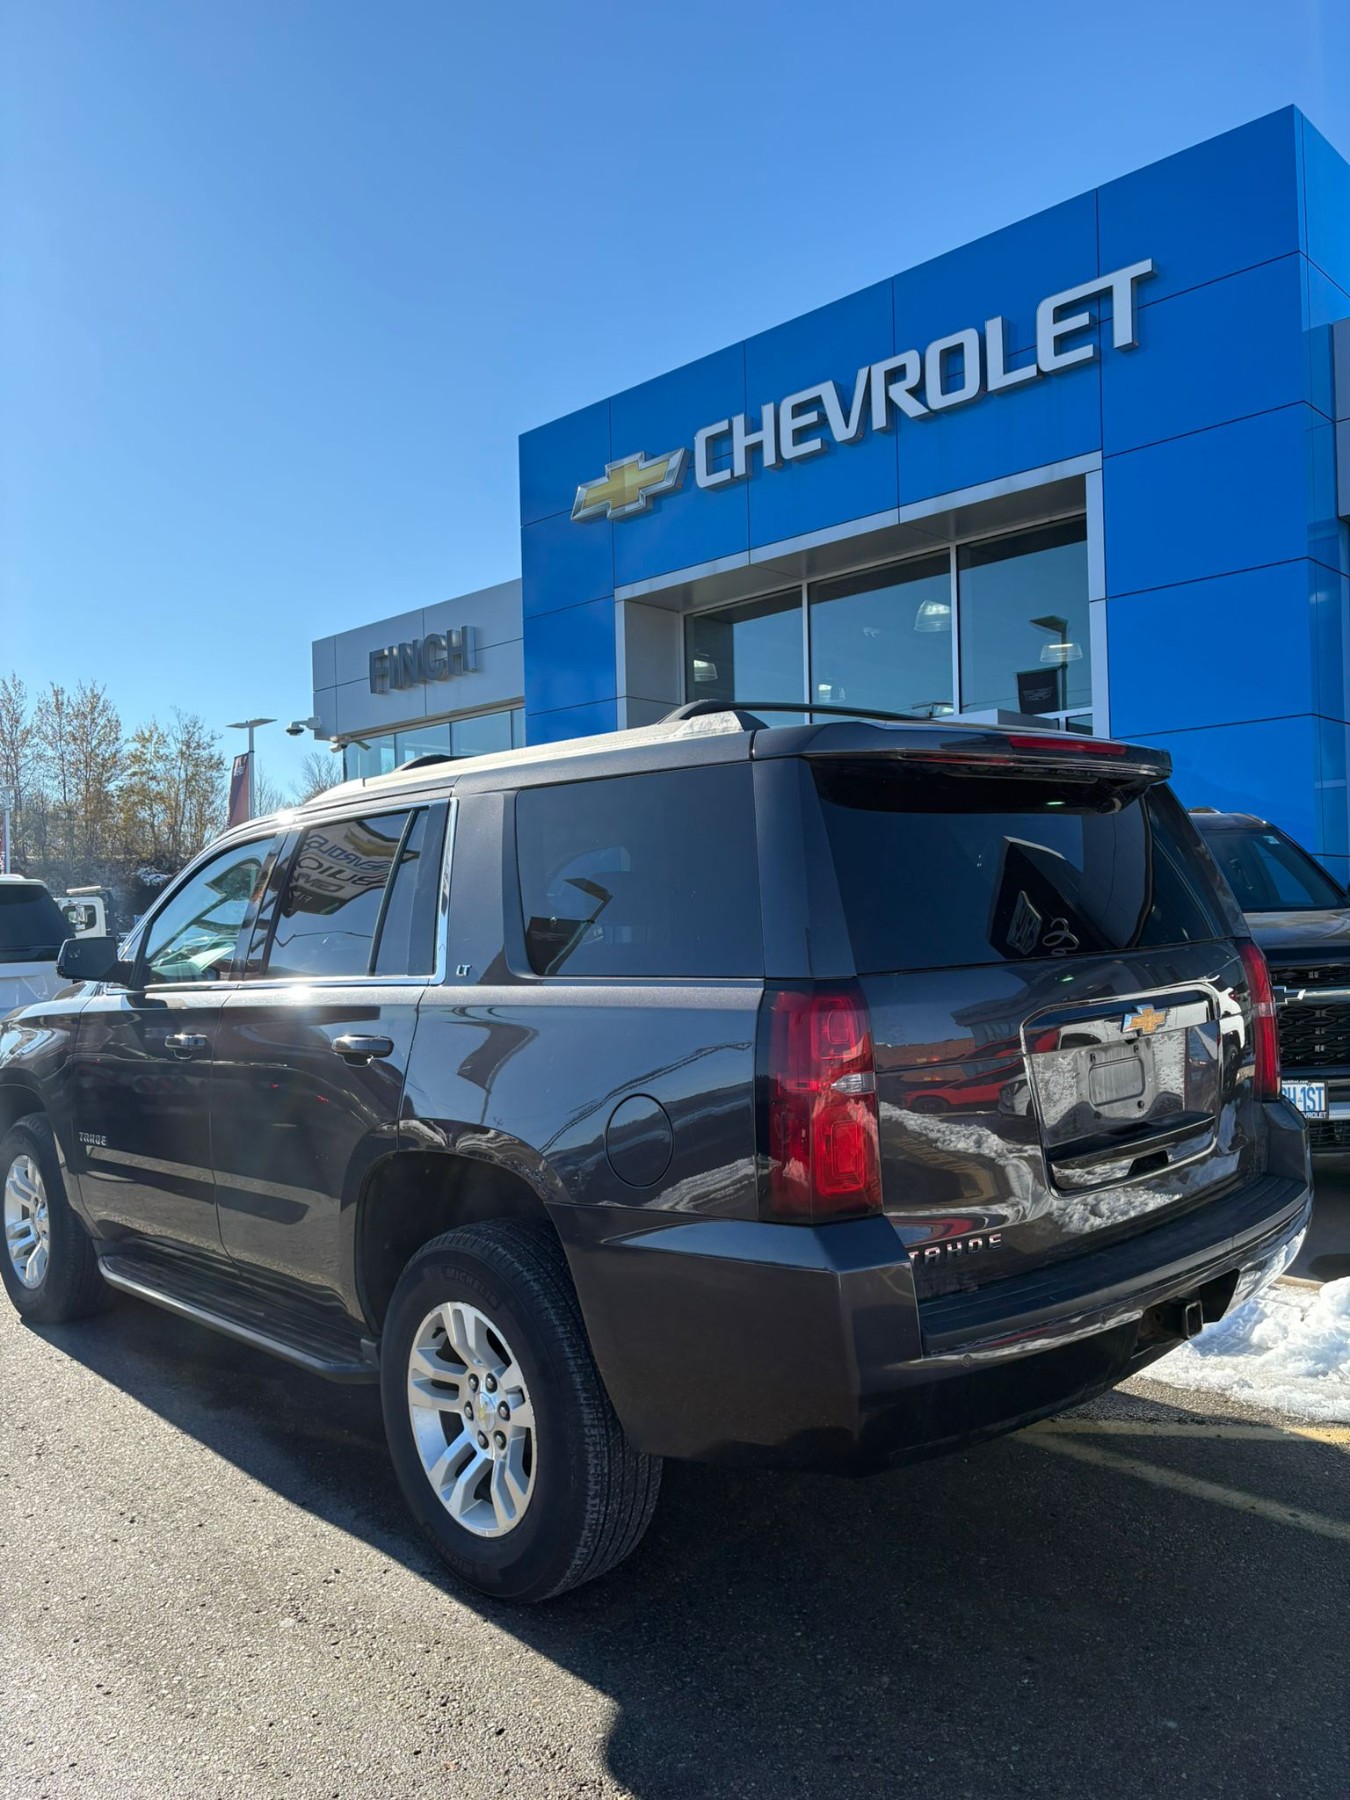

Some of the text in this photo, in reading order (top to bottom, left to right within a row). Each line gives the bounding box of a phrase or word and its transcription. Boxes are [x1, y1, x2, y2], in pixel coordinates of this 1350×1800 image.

[695, 258, 1158, 490] CHEVROLET
[369, 625, 478, 695] FINCH
[455, 963, 473, 977] LT
[79, 1131, 107, 1146] TAHOE
[908, 1233, 1002, 1264] TAHOE
